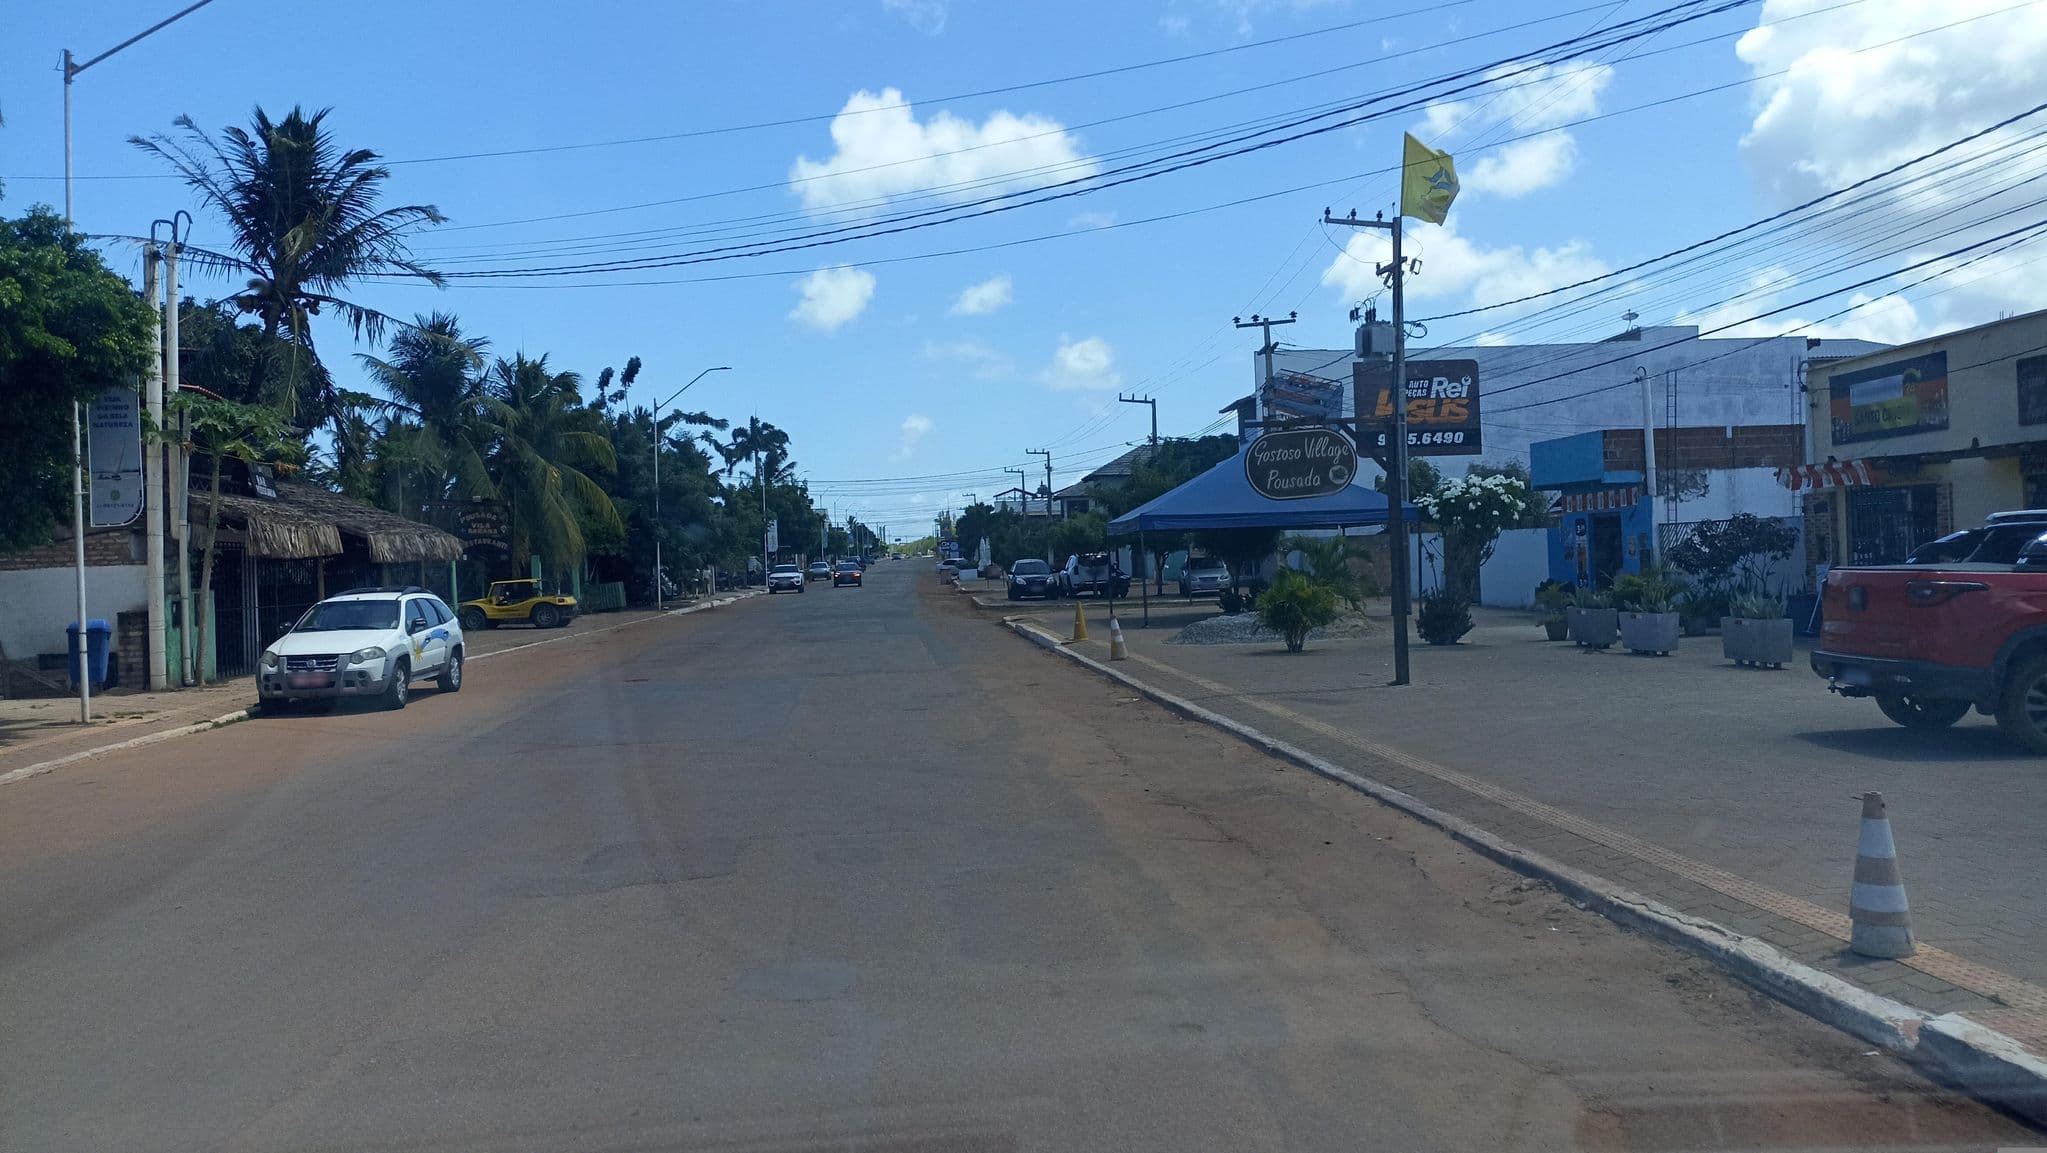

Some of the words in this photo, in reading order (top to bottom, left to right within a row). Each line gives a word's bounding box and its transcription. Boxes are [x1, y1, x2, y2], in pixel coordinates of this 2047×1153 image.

[1408, 380, 1429, 389] AUTO
[1430, 376, 1471, 399] Rei
[1254, 441, 1301, 466] Gostoso
[1304, 436, 1350, 465] Village
[1266, 467, 1321, 490] Pousada
